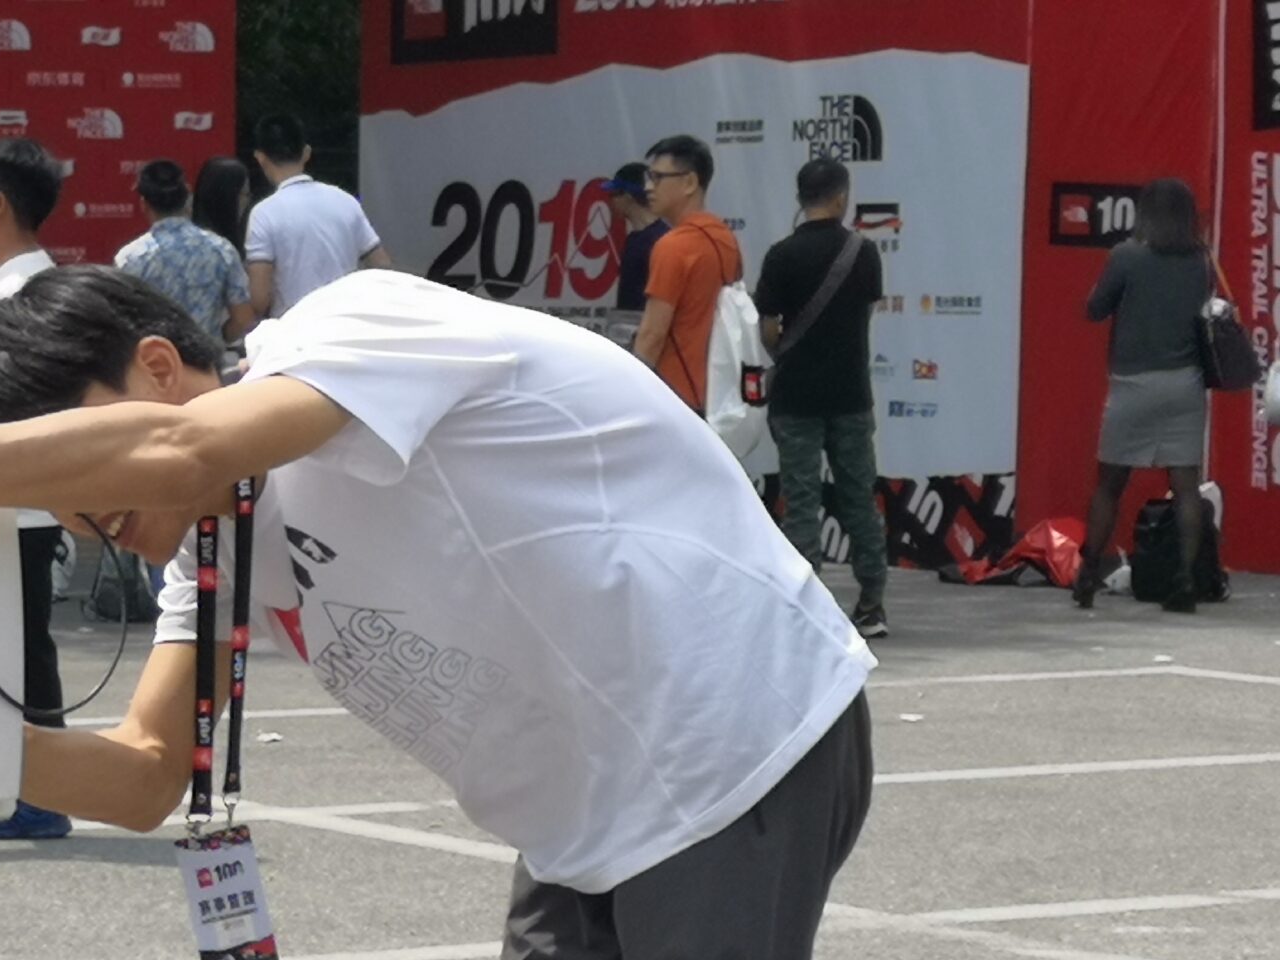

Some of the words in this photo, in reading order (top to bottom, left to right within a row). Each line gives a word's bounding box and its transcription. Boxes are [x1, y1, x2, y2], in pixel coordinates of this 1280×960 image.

[820, 95, 851, 117] THE
[792, 119, 852, 142] NORTH
[809, 142, 851, 162] FACE
[1250, 152, 1269, 238] ULTRA
[427, 177, 627, 300] 2019
[1251, 246, 1269, 320] TRAIL
